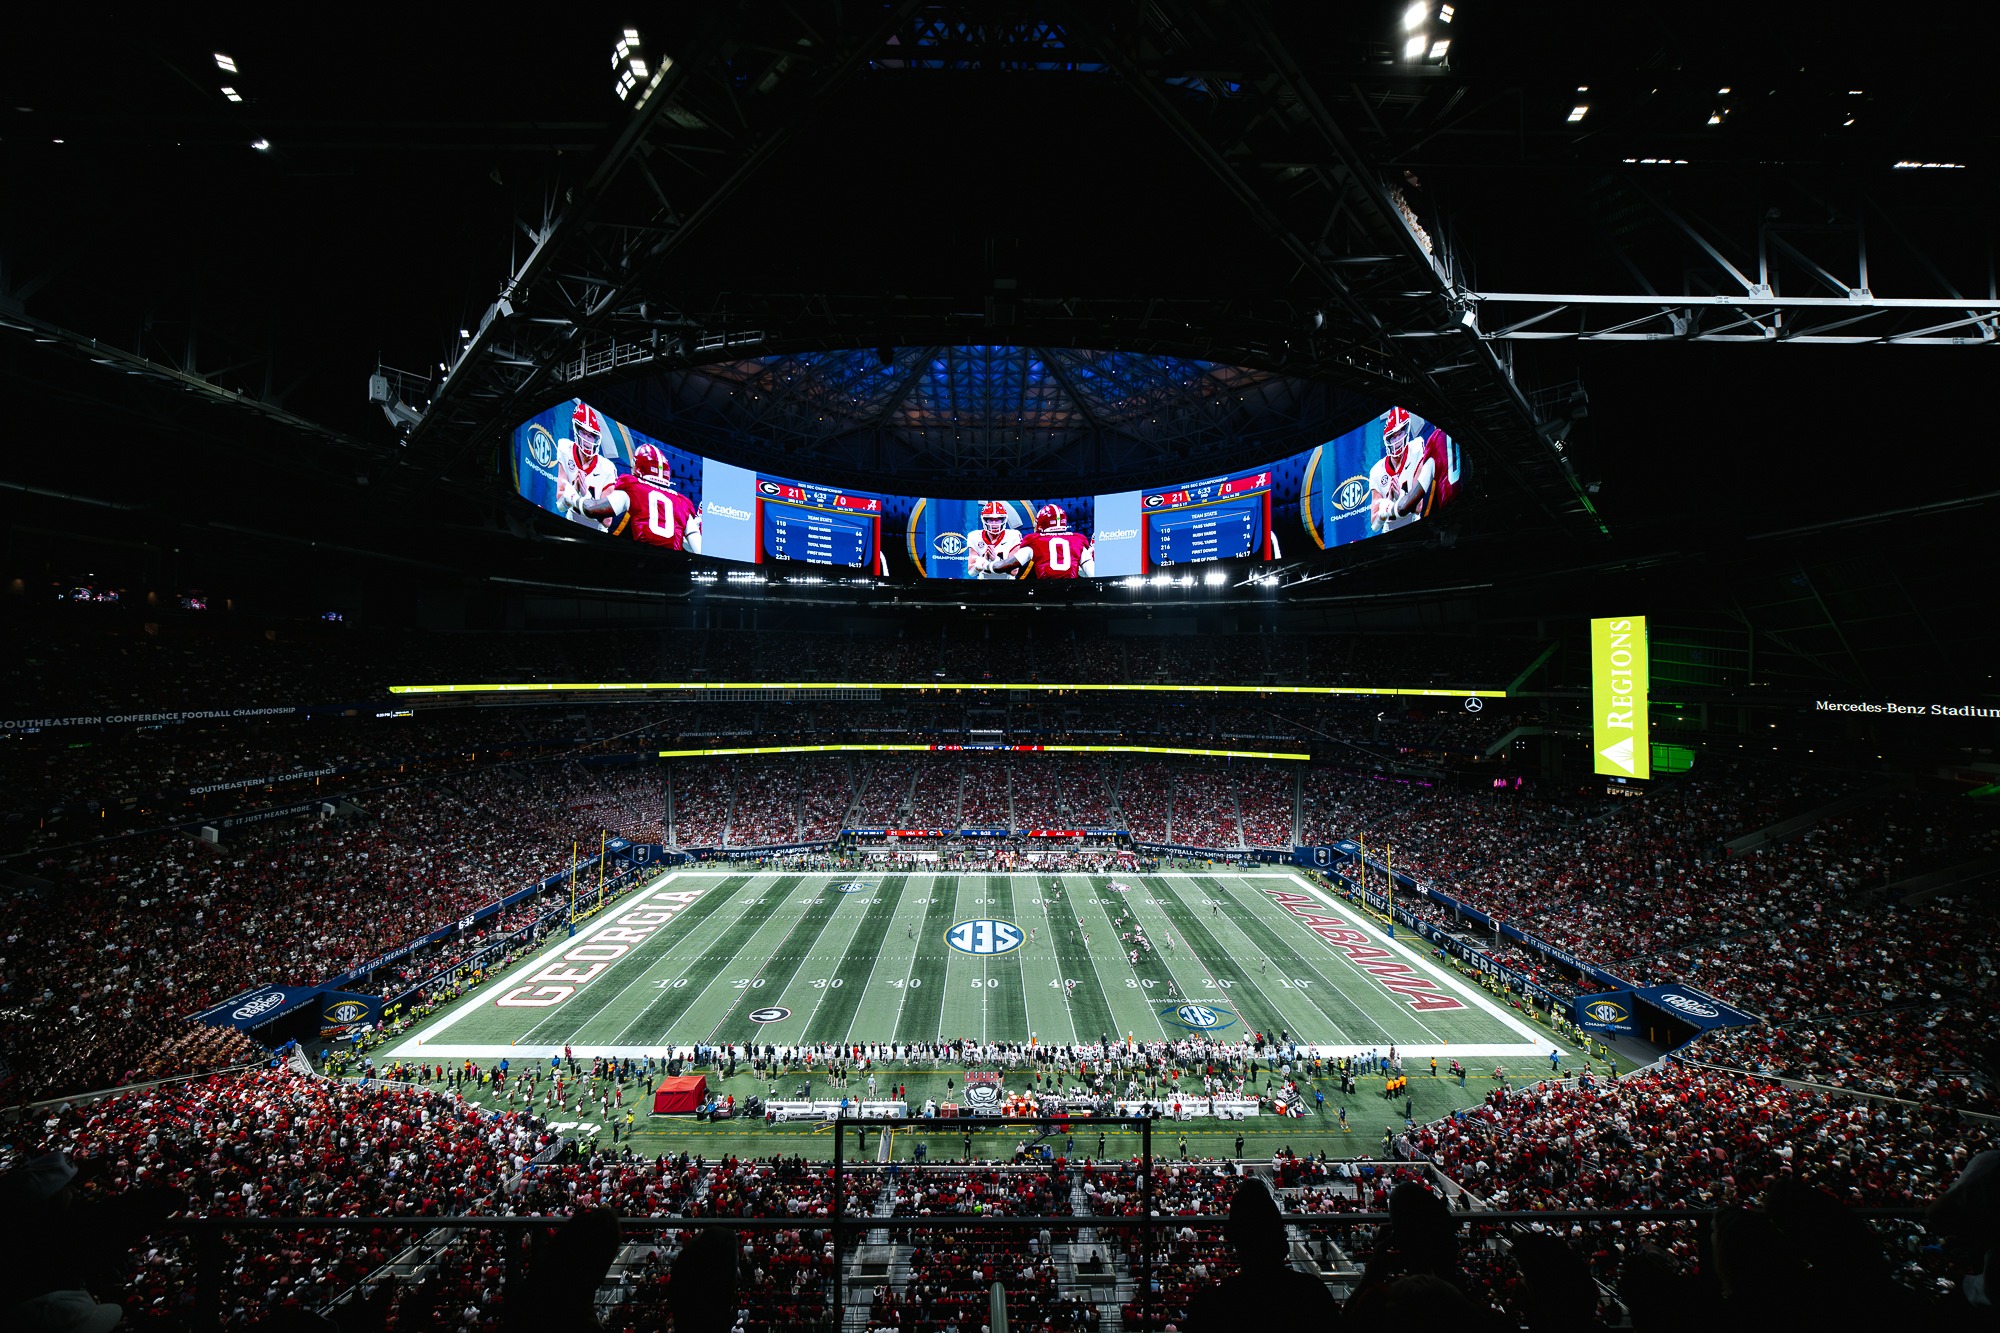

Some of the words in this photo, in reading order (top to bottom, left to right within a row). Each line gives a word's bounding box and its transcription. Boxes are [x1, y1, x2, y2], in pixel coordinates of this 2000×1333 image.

[535, 433, 551, 465] SEC
[788, 487, 799, 499] 21
[1197, 486, 1212, 496] 6:33
[1225, 483, 1232, 493] 0
[813, 492, 827, 501] 6:33
[840, 496, 847, 506] 0
[1171, 492, 1183, 503] 21
[1342, 482, 1361, 509] SEC
[648, 490, 675, 539] 0
[707, 501, 751, 522] Academy
[776, 519, 787, 527] 110
[775, 536, 787, 544] 216
[1098, 528, 1139, 540] Academy
[1160, 535, 1171, 543] 106
[944, 537, 960, 553] SEC
[1160, 543, 1171, 551] 216
[775, 554, 791, 562] 22:31
[1048, 537, 1071, 571] 0
[1606, 619, 1634, 731] REGIONS
[1815, 700, 1926, 715] Mercedes-Benz
[0, 716, 102, 730] SOUTHEASTERN
[106, 712, 179, 724] CONFERENCE
[181, 710, 231, 720] FOOTBALL
[232, 707, 296, 718] CHAMPIONSHIP
[189, 777, 265, 796] SOUTHEASTERN
[277, 767, 337, 782] CONFERENCE
[235, 817, 244, 825] IT
[244, 813, 263, 824] JUST
[263, 809, 289, 820] MEANS
[458, 915, 475, 931] 6:32
[950, 919, 1021, 953] SEC
[494, 889, 707, 1008] GEORGIA
[1260, 888, 1471, 1013] ALABAMA
[1530, 938, 1537, 946] IT
[1536, 941, 1551, 955] JUST
[1550, 948, 1574, 967] MEANS
[358, 965, 367, 975] IT
[366, 959, 384, 972] JUST
[384, 946, 408, 962] MEANS
[660, 978, 688, 989] 10
[742, 978, 766, 989] 20
[817, 978, 844, 989] 30
[894, 978, 921, 989] 40
[970, 978, 998, 989] 50
[1049, 978, 1076, 989] 40
[1125, 978, 1154, 989] 30
[1201, 978, 1232, 989] 20
[1276, 978, 1308, 989] 10
[236, 993, 280, 1018] Pepper
[243, 996, 264, 1009] Dr
[293, 997, 315, 1011] Stadium
[1662, 994, 1716, 1016] Pepper
[337, 1005, 356, 1022] SEC
[1180, 1005, 1216, 1026] SEC
[1597, 1005, 1616, 1022] SEC
[1680, 1013, 1707, 1030] Stadium
